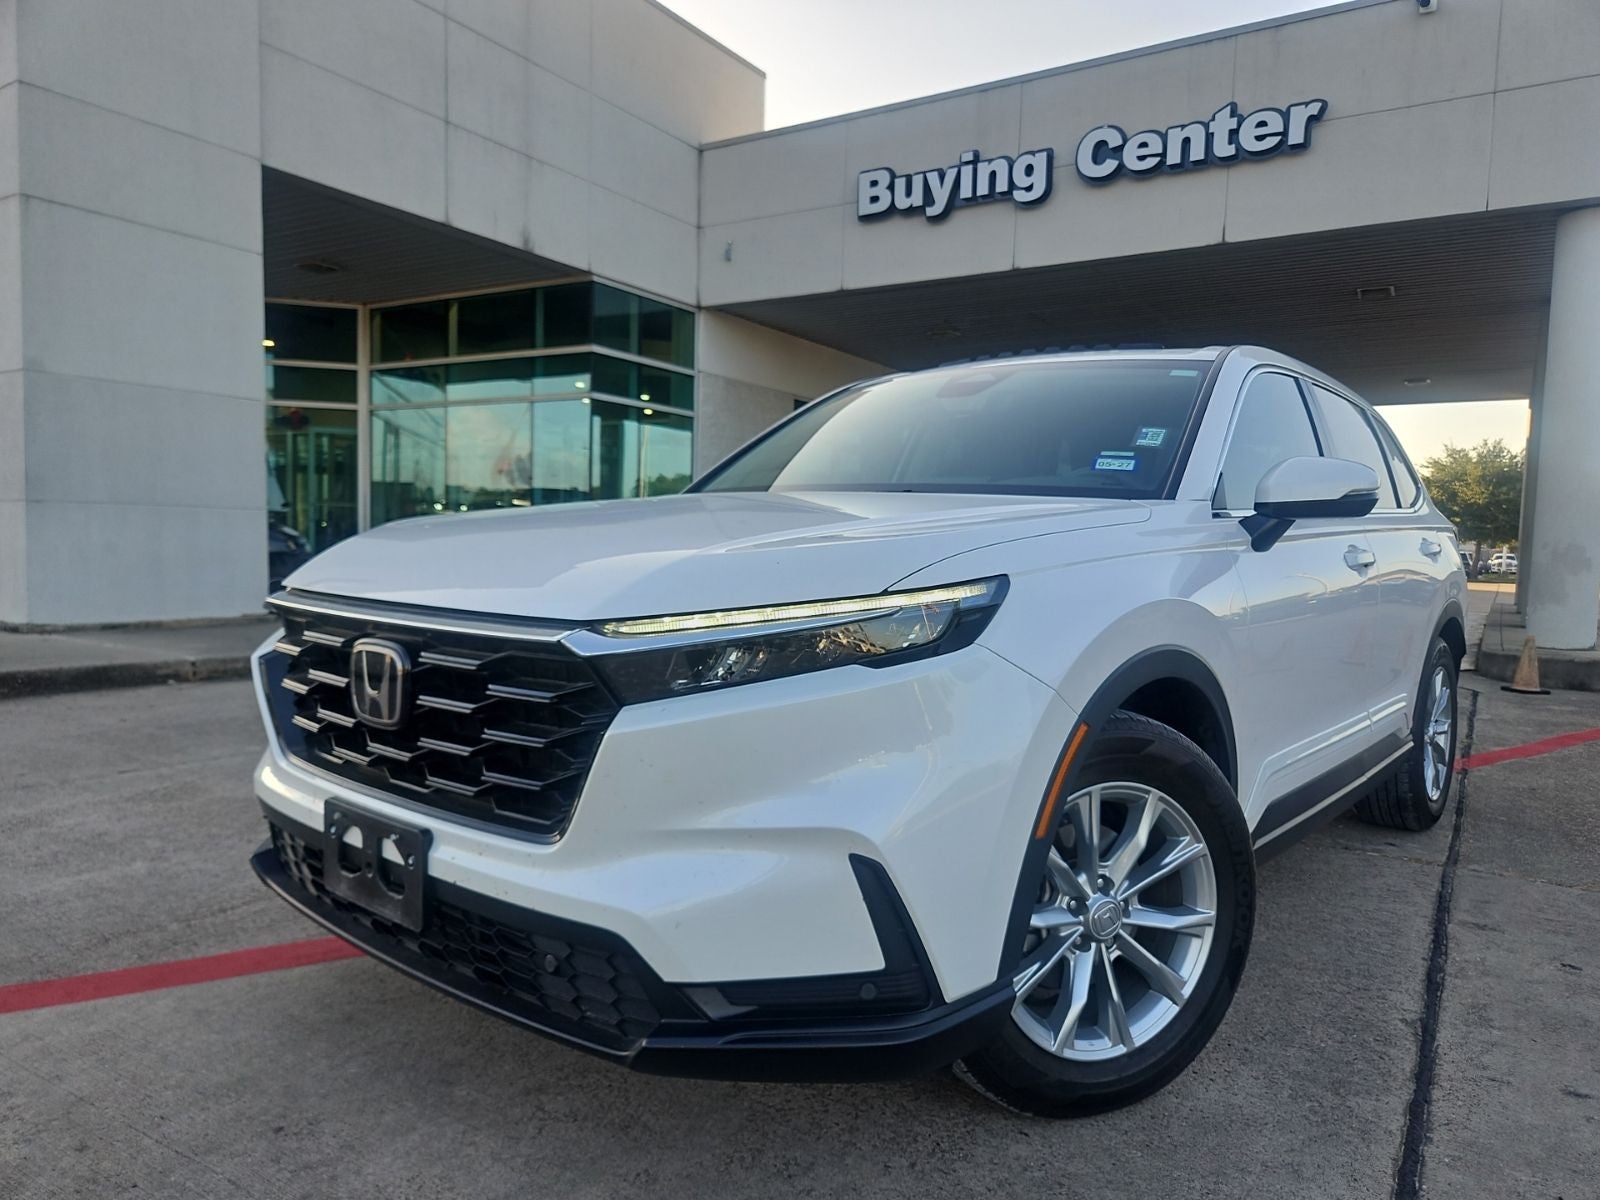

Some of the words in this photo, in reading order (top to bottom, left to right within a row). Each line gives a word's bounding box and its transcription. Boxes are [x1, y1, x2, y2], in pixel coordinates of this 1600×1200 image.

[857, 150, 1051, 218] Buying
[1076, 100, 1324, 180] Center
[1097, 461, 1132, 469] 05-27
